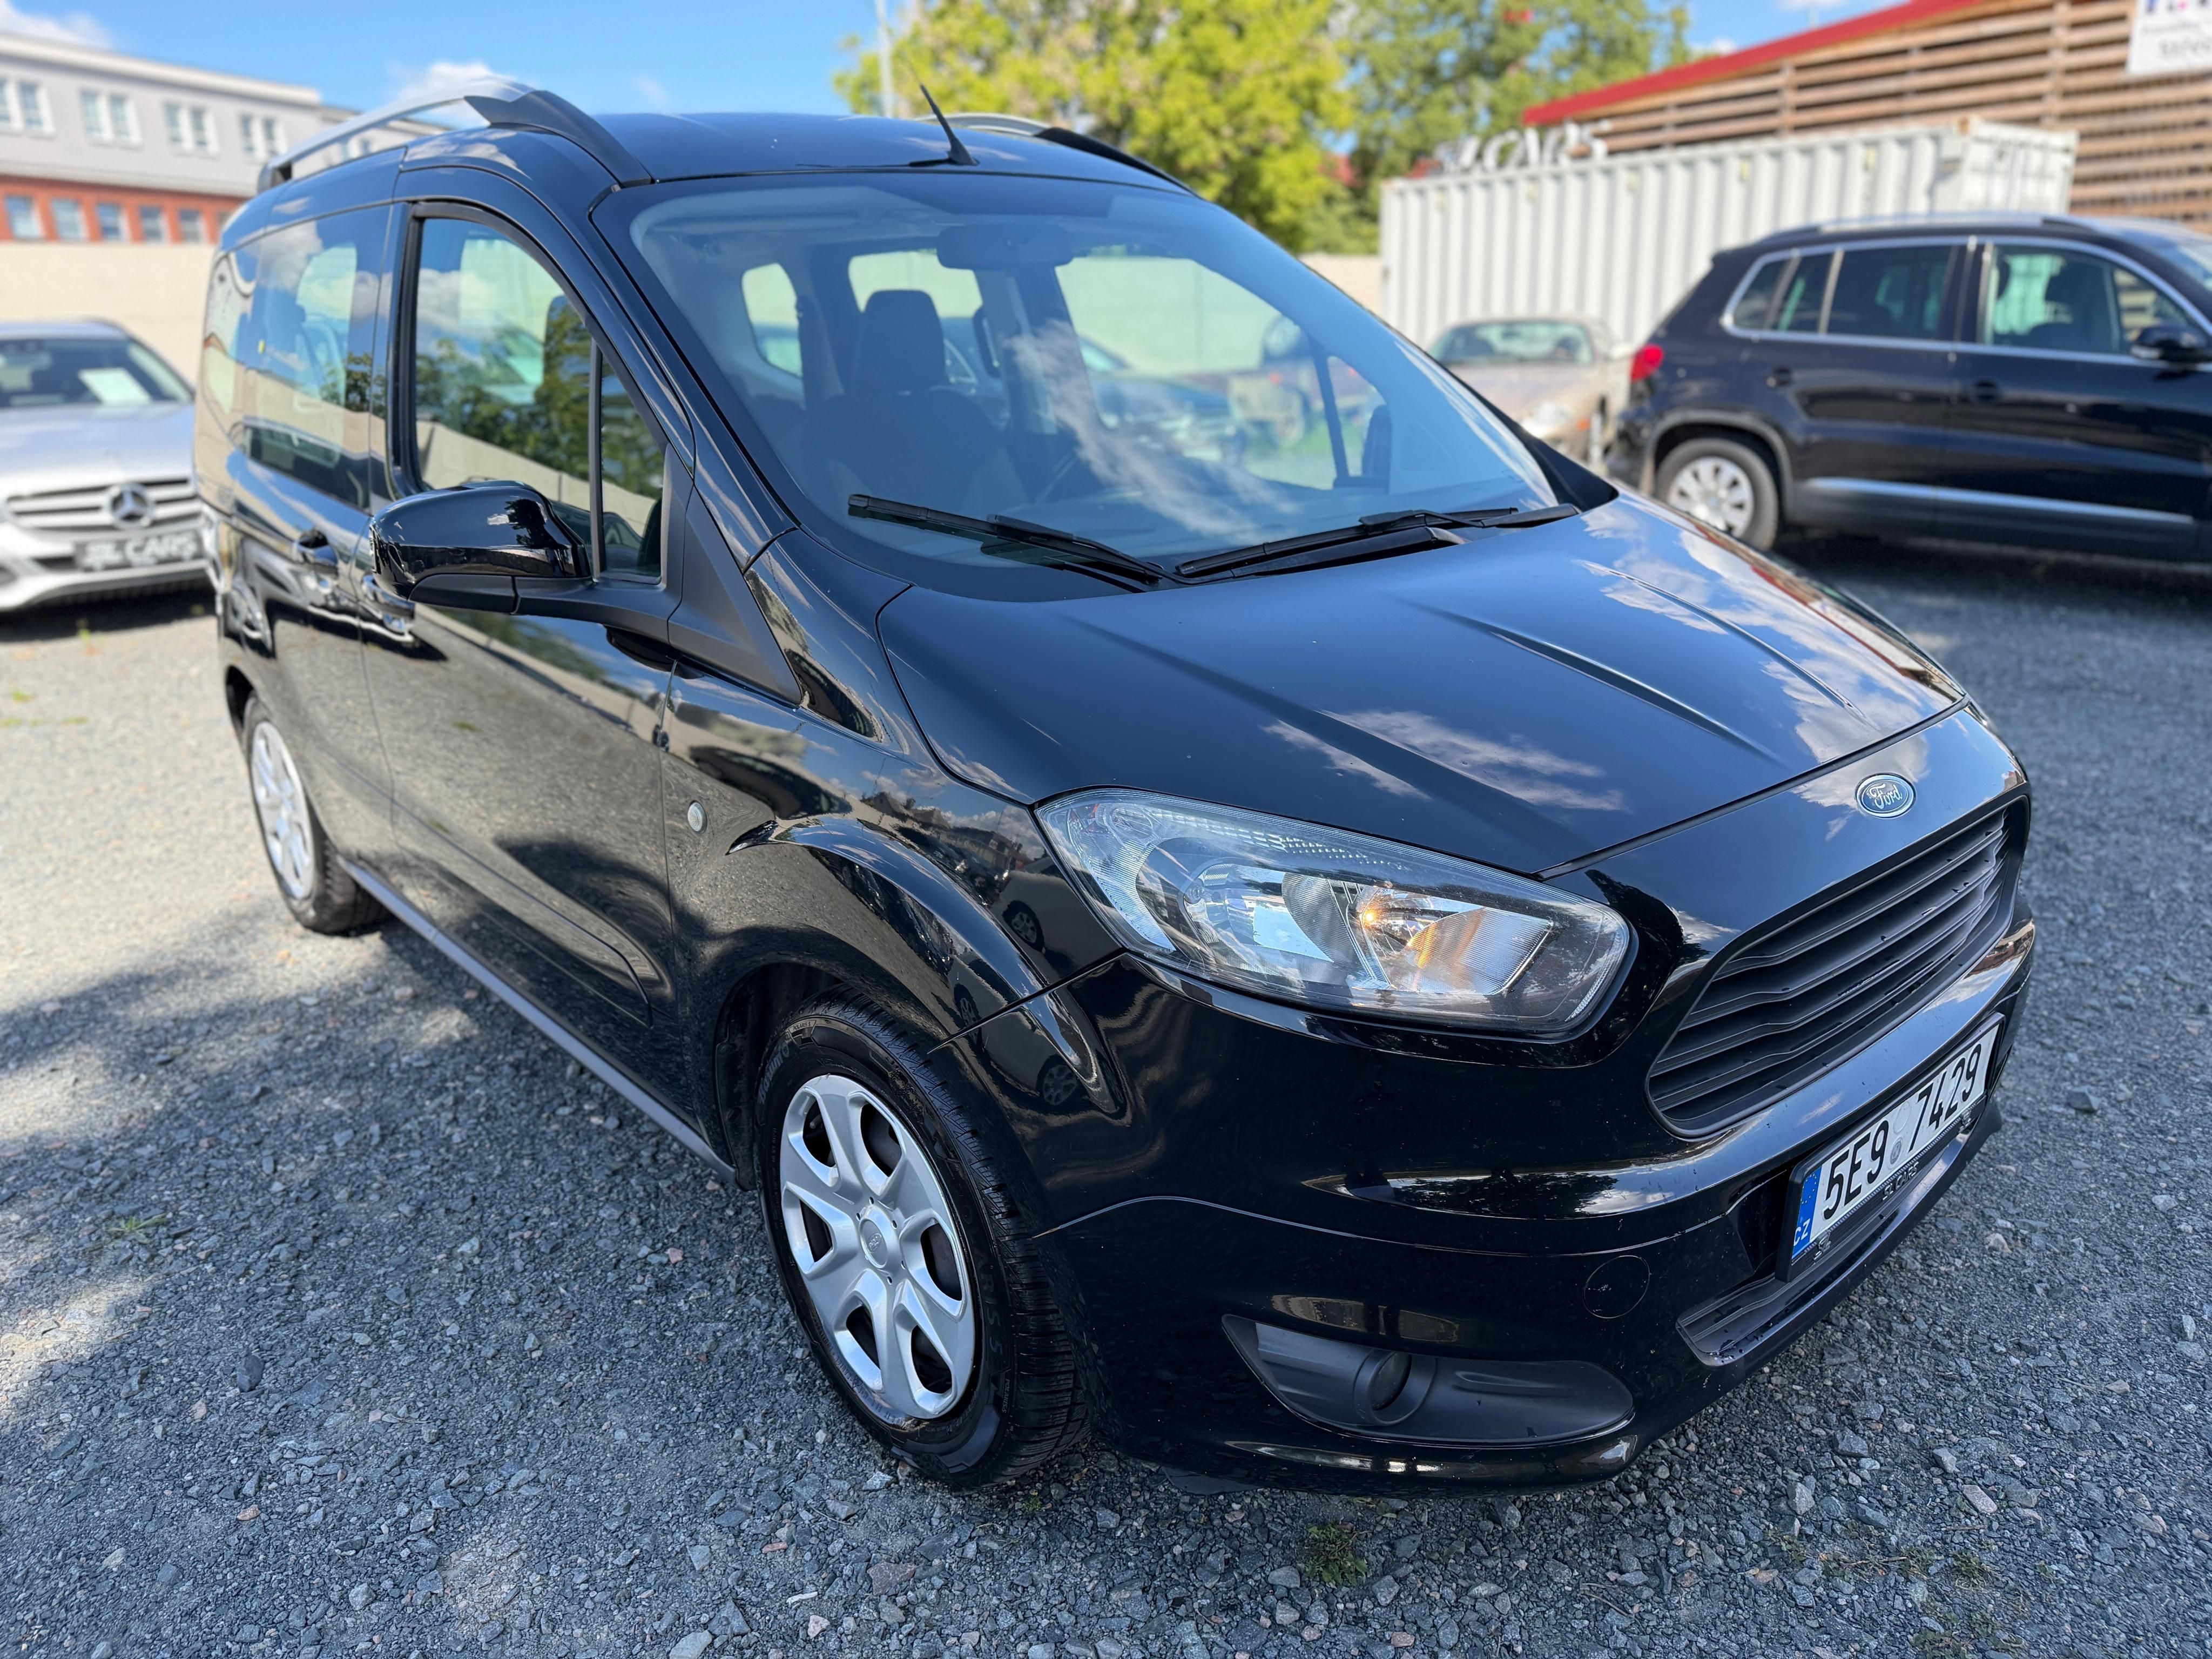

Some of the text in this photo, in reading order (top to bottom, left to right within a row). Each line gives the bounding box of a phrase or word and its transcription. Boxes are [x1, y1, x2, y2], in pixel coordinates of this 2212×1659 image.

[1868, 784, 1903, 809] Ford
[1823, 1043, 1982, 1220] 5E9 7429
[1896, 1161, 1919, 1190] CARS
[1793, 1218, 1811, 1246] CZ
